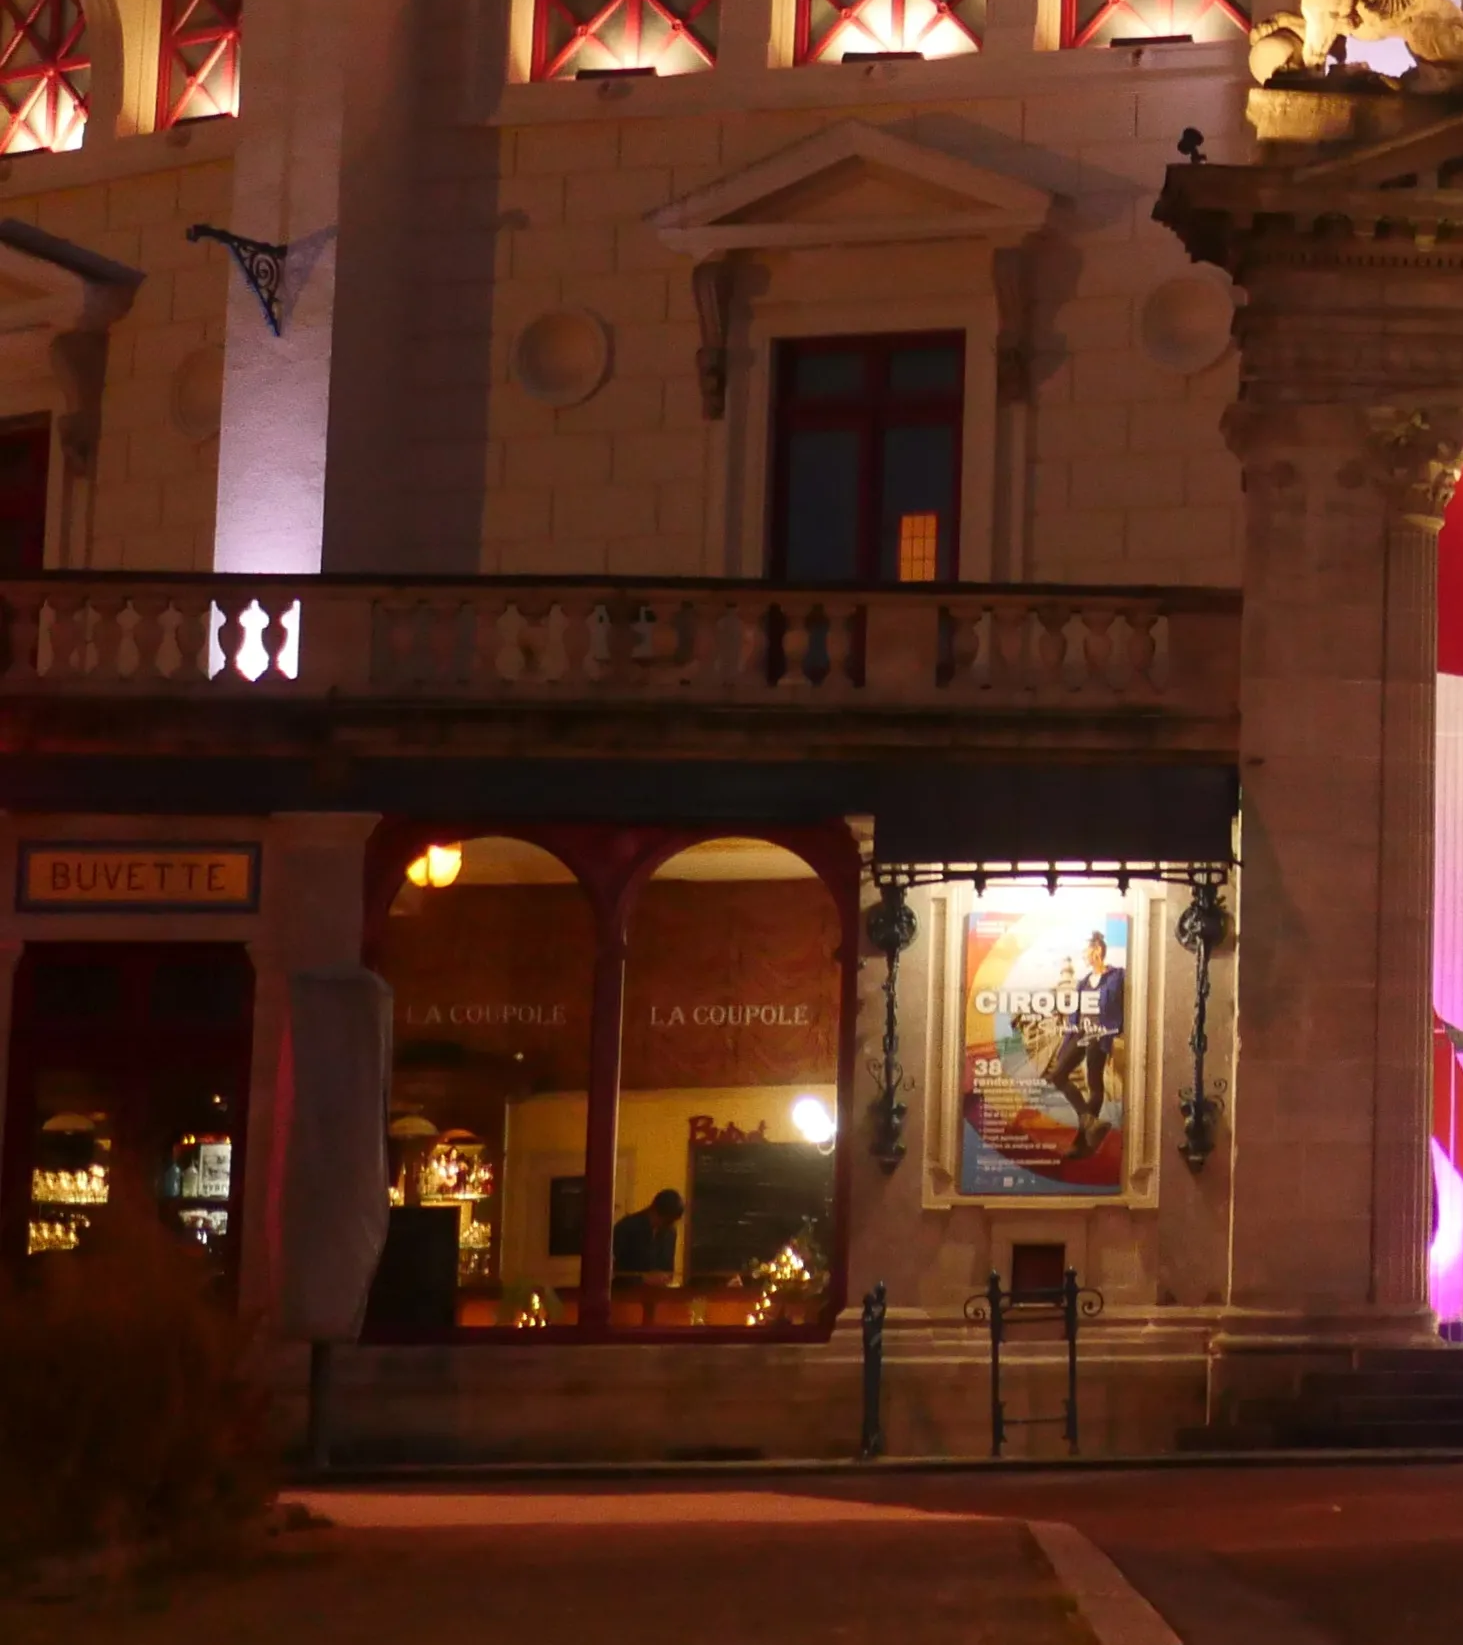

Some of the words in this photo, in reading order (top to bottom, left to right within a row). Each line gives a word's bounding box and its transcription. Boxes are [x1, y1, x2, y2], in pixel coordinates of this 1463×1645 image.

[49, 861, 227, 893] BUVETTE
[405, 1003, 443, 1025] LA
[449, 1003, 567, 1026] COUPOLE
[974, 990, 1101, 1017] CIRQUE
[649, 1004, 686, 1027] LA
[692, 1004, 810, 1027] COUPOLE
[974, 1058, 1003, 1076] 38
